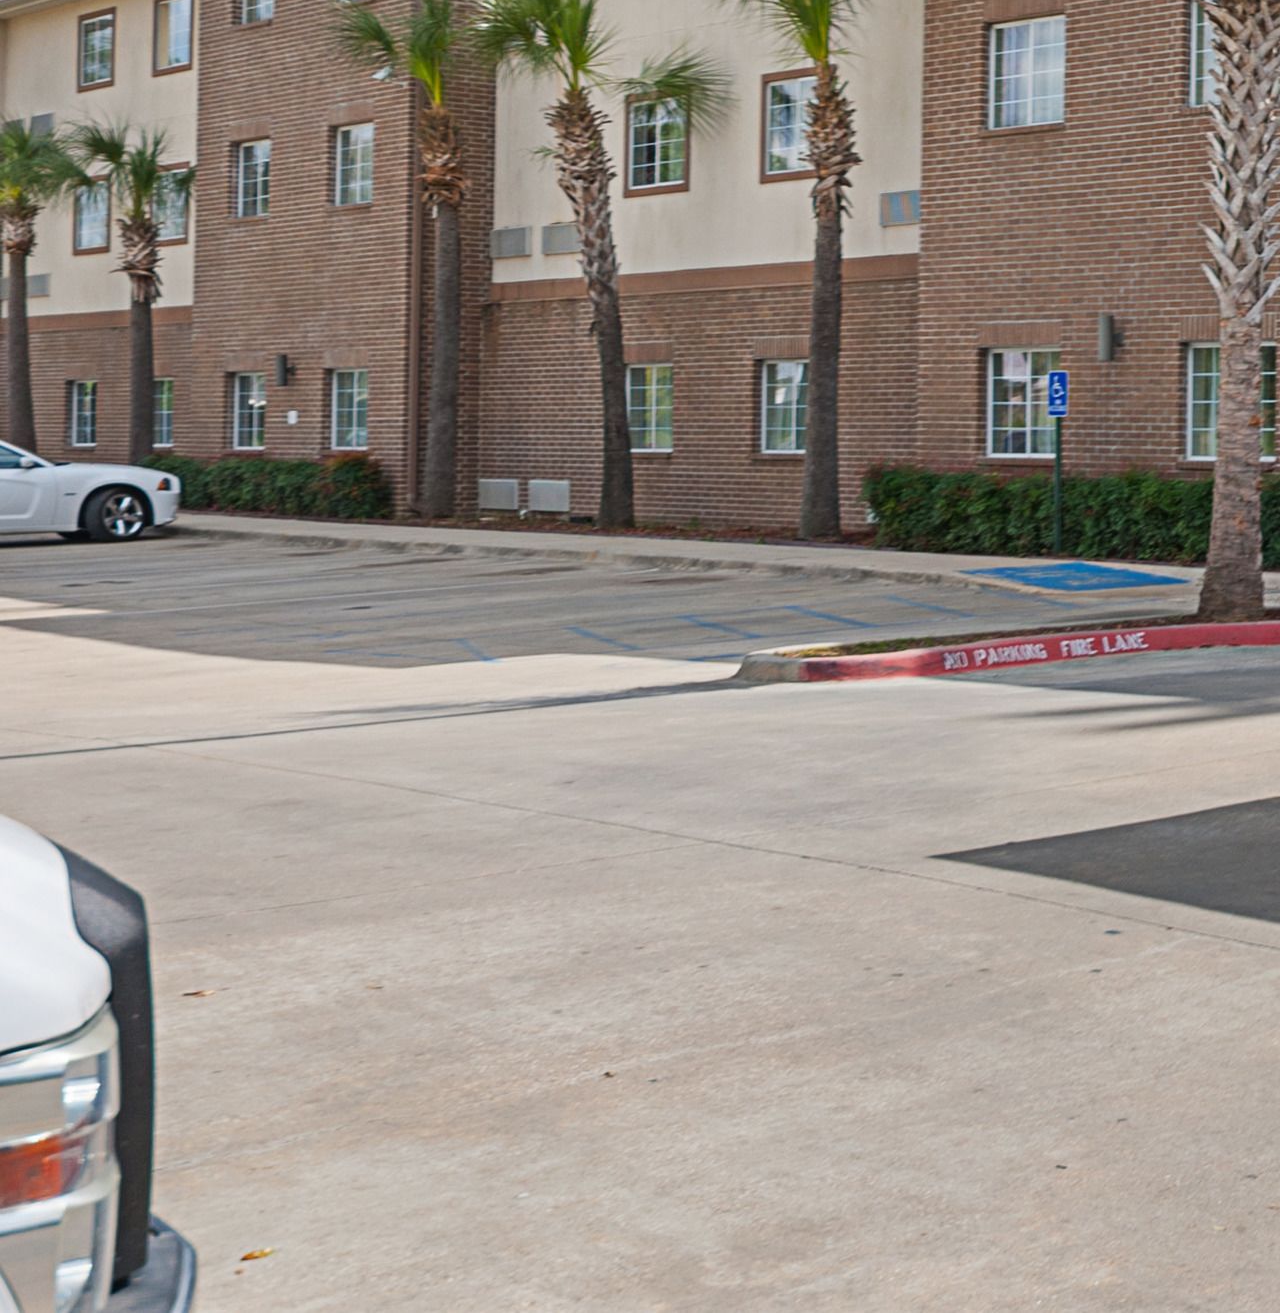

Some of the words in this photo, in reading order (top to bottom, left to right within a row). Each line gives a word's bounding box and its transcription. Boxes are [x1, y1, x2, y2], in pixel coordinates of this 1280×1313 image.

[943, 651, 969, 670] NO
[974, 643, 1049, 667] PARKING
[1060, 637, 1099, 658] FIRE
[1102, 631, 1149, 654] LANE
